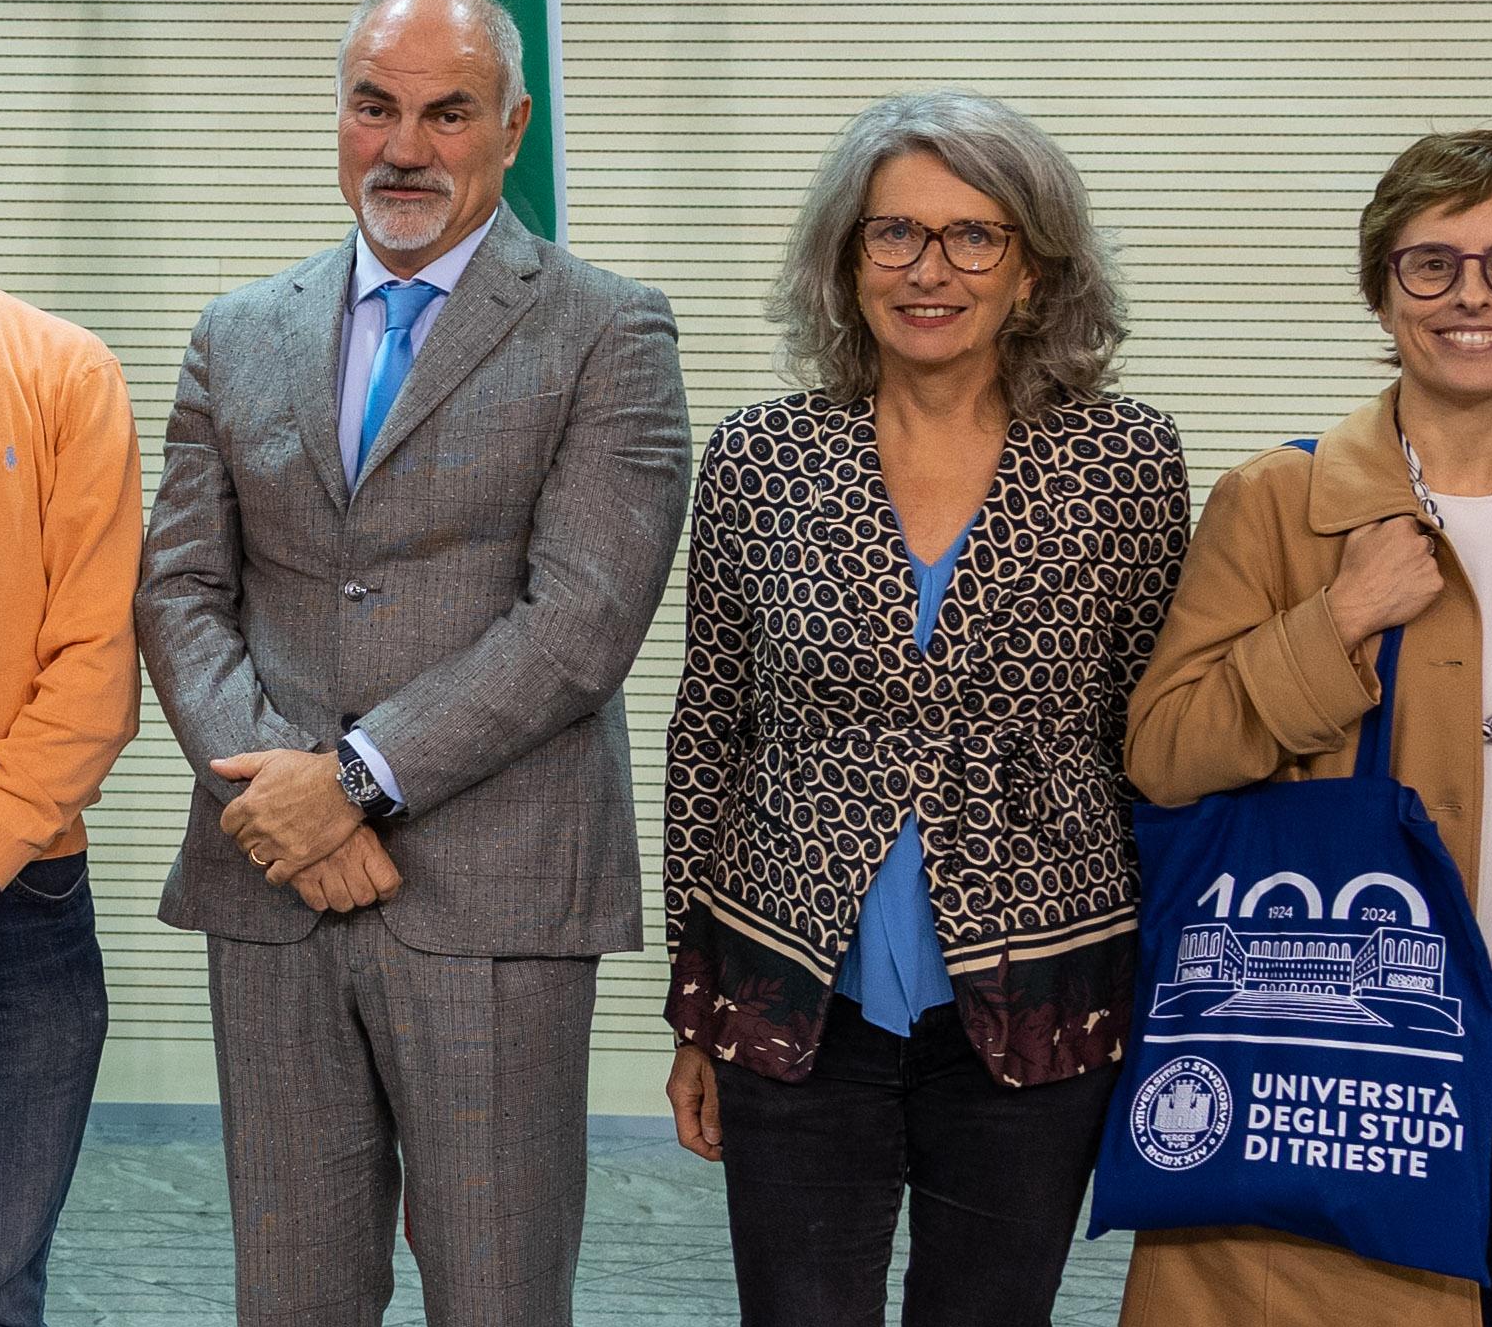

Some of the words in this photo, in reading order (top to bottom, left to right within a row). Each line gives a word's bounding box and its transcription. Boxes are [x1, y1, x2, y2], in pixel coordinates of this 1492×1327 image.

[1267, 906, 1294, 919] 1924
[1360, 907, 1397, 923] 2024
[1251, 1072, 1460, 1120] UNIVERSITÀ
[1246, 1104, 1347, 1138] DEGLI
[1359, 1116, 1464, 1152] STUDI
[1244, 1135, 1279, 1163] DI
[1287, 1139, 1428, 1179] TRIESTE
